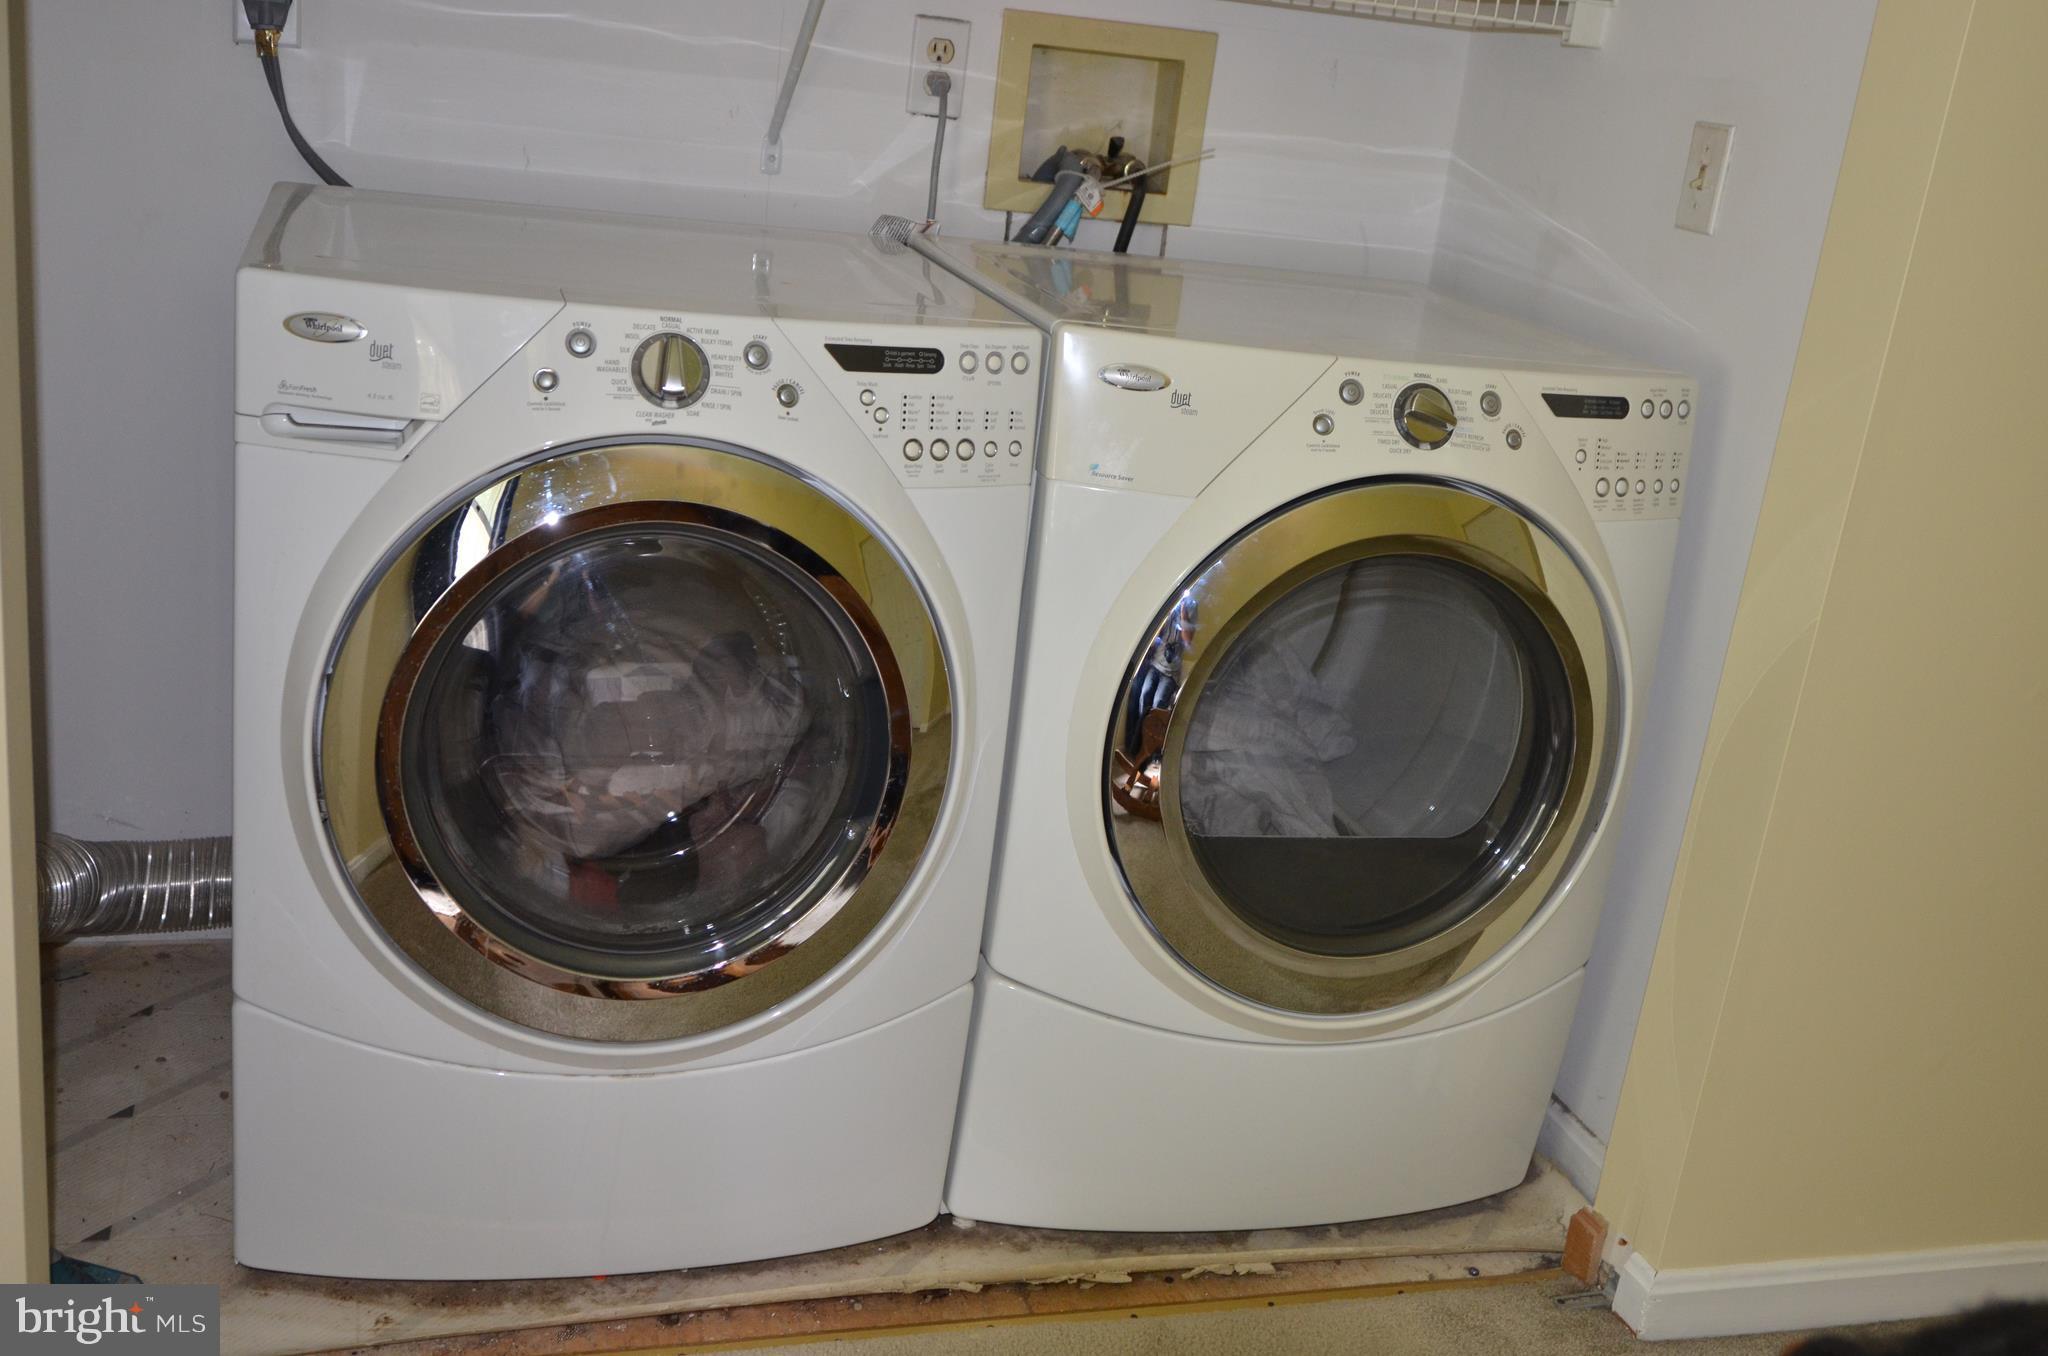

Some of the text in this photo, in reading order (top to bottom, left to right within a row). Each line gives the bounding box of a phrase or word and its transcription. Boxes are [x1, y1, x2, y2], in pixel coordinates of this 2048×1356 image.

[660, 316, 682, 324] NORMAL
[304, 317, 342, 333] Whirlpool
[632, 322, 656, 331] DELICATE
[661, 322, 681, 330] CASUAL
[686, 327, 719, 336] ACTIVE WEAR
[369, 340, 393, 360] duet
[1118, 369, 1152, 384] Whirlpool
[1170, 389, 1192, 408] duet
[1181, 407, 1199, 417] steam
[1117, 474, 1134, 482] Saver
